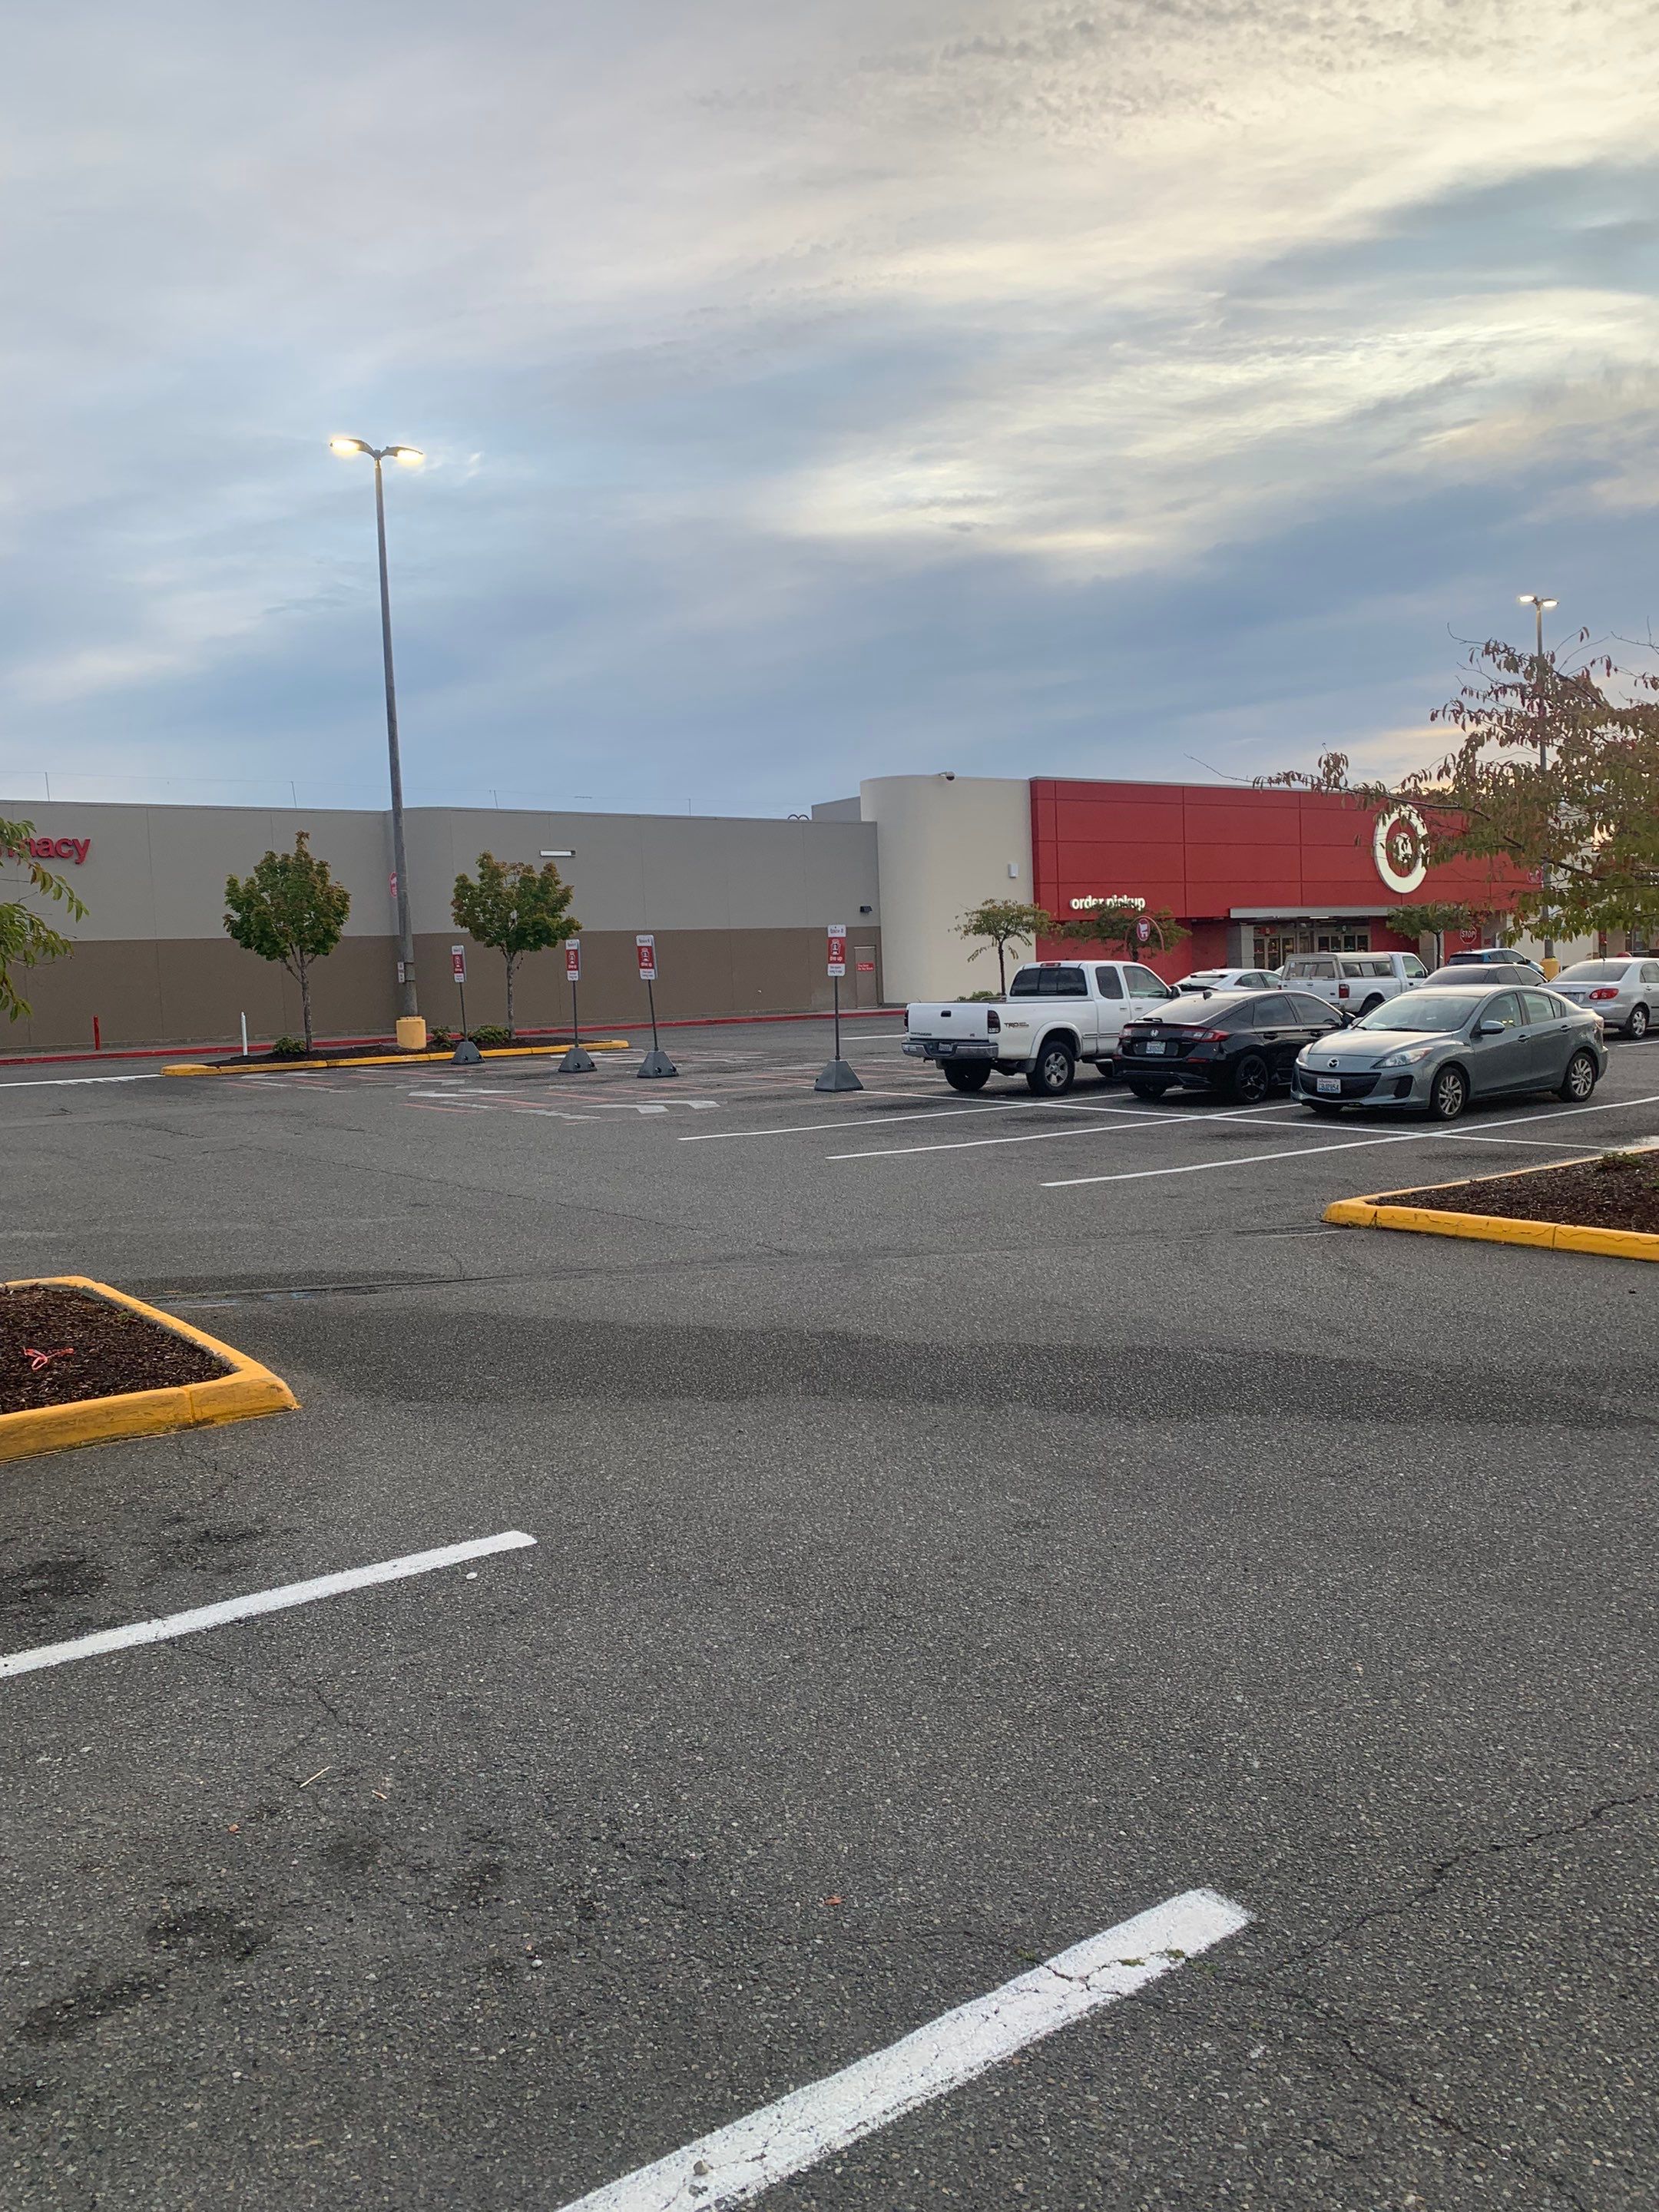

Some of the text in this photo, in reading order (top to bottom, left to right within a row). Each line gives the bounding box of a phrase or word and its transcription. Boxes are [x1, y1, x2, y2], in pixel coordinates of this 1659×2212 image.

[0, 837, 91, 864] macy
[1070, 894, 1145, 911] order pickup
